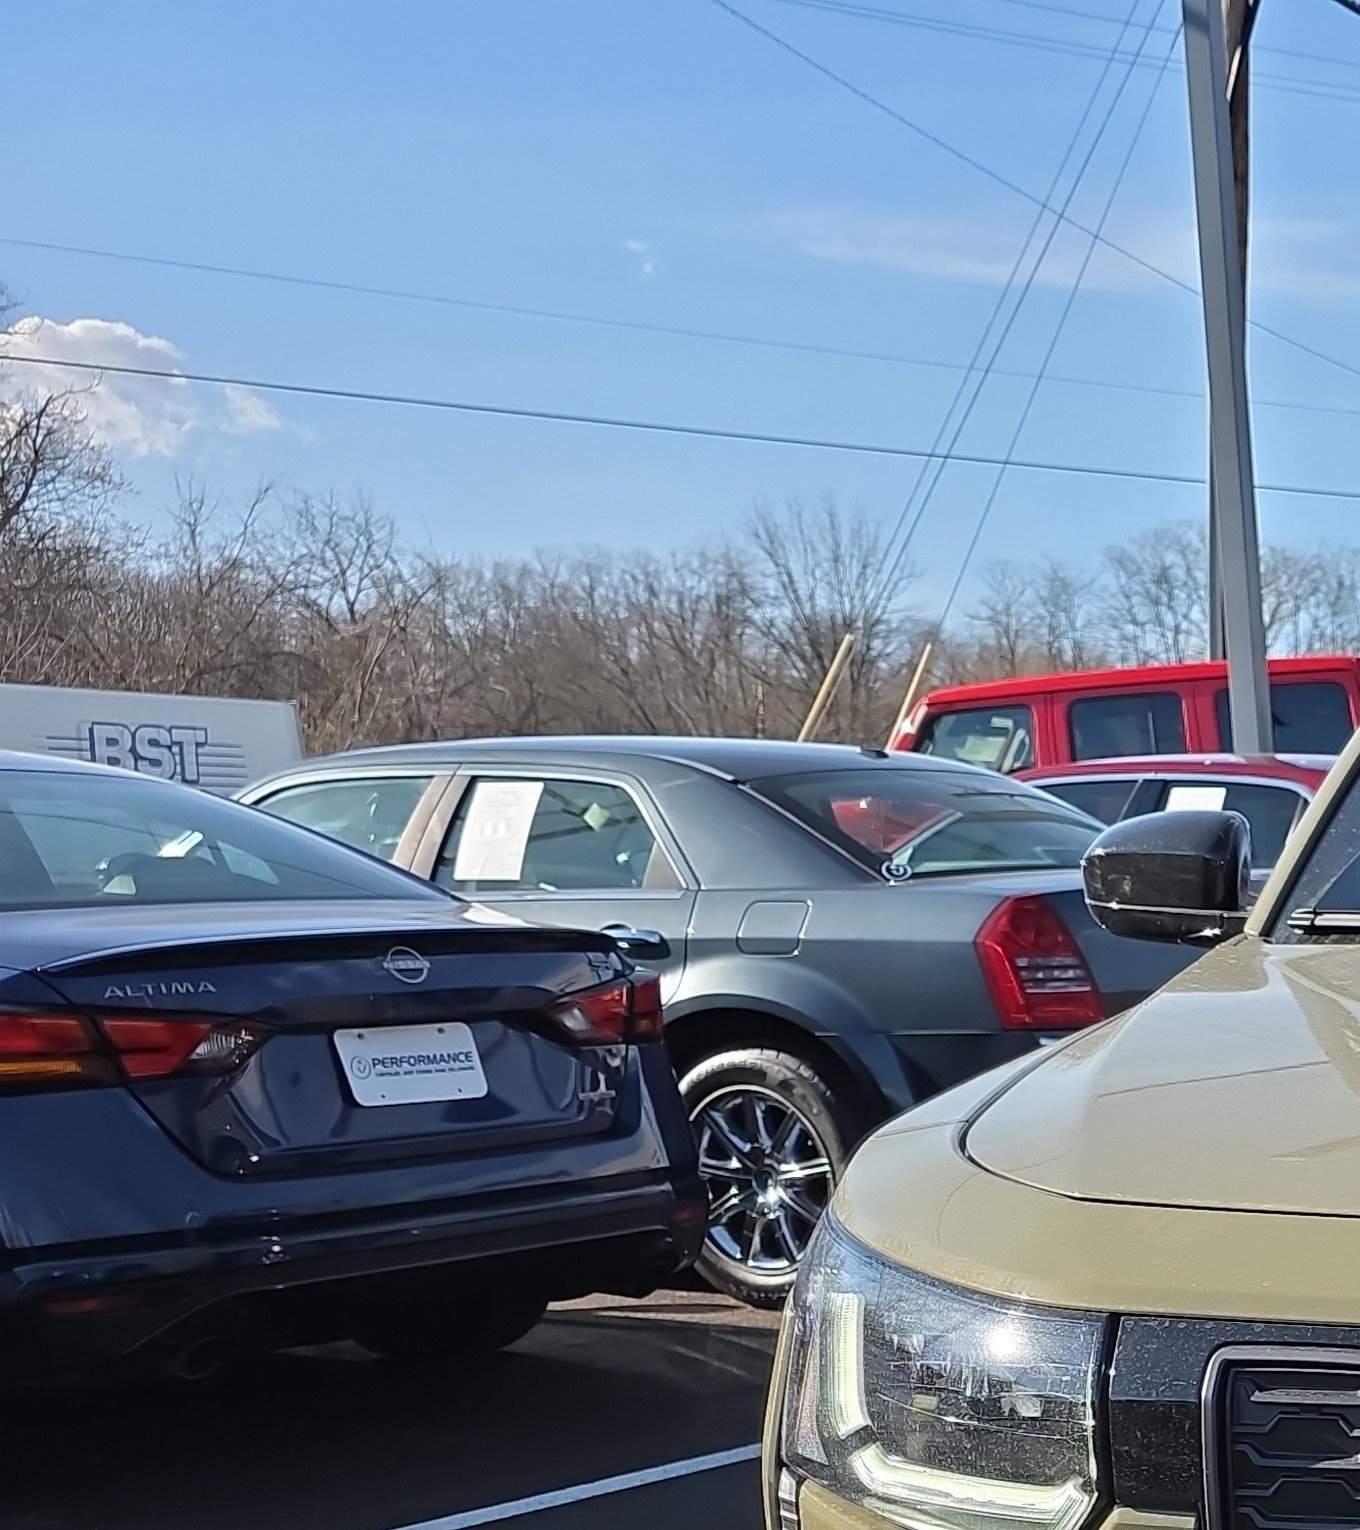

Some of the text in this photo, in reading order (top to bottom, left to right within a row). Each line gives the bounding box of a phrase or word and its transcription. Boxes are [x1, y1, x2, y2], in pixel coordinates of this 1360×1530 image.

[89, 721, 208, 784] BST
[104, 981, 217, 999] ALTIMA
[371, 1051, 474, 1069] PERFORMANCE
